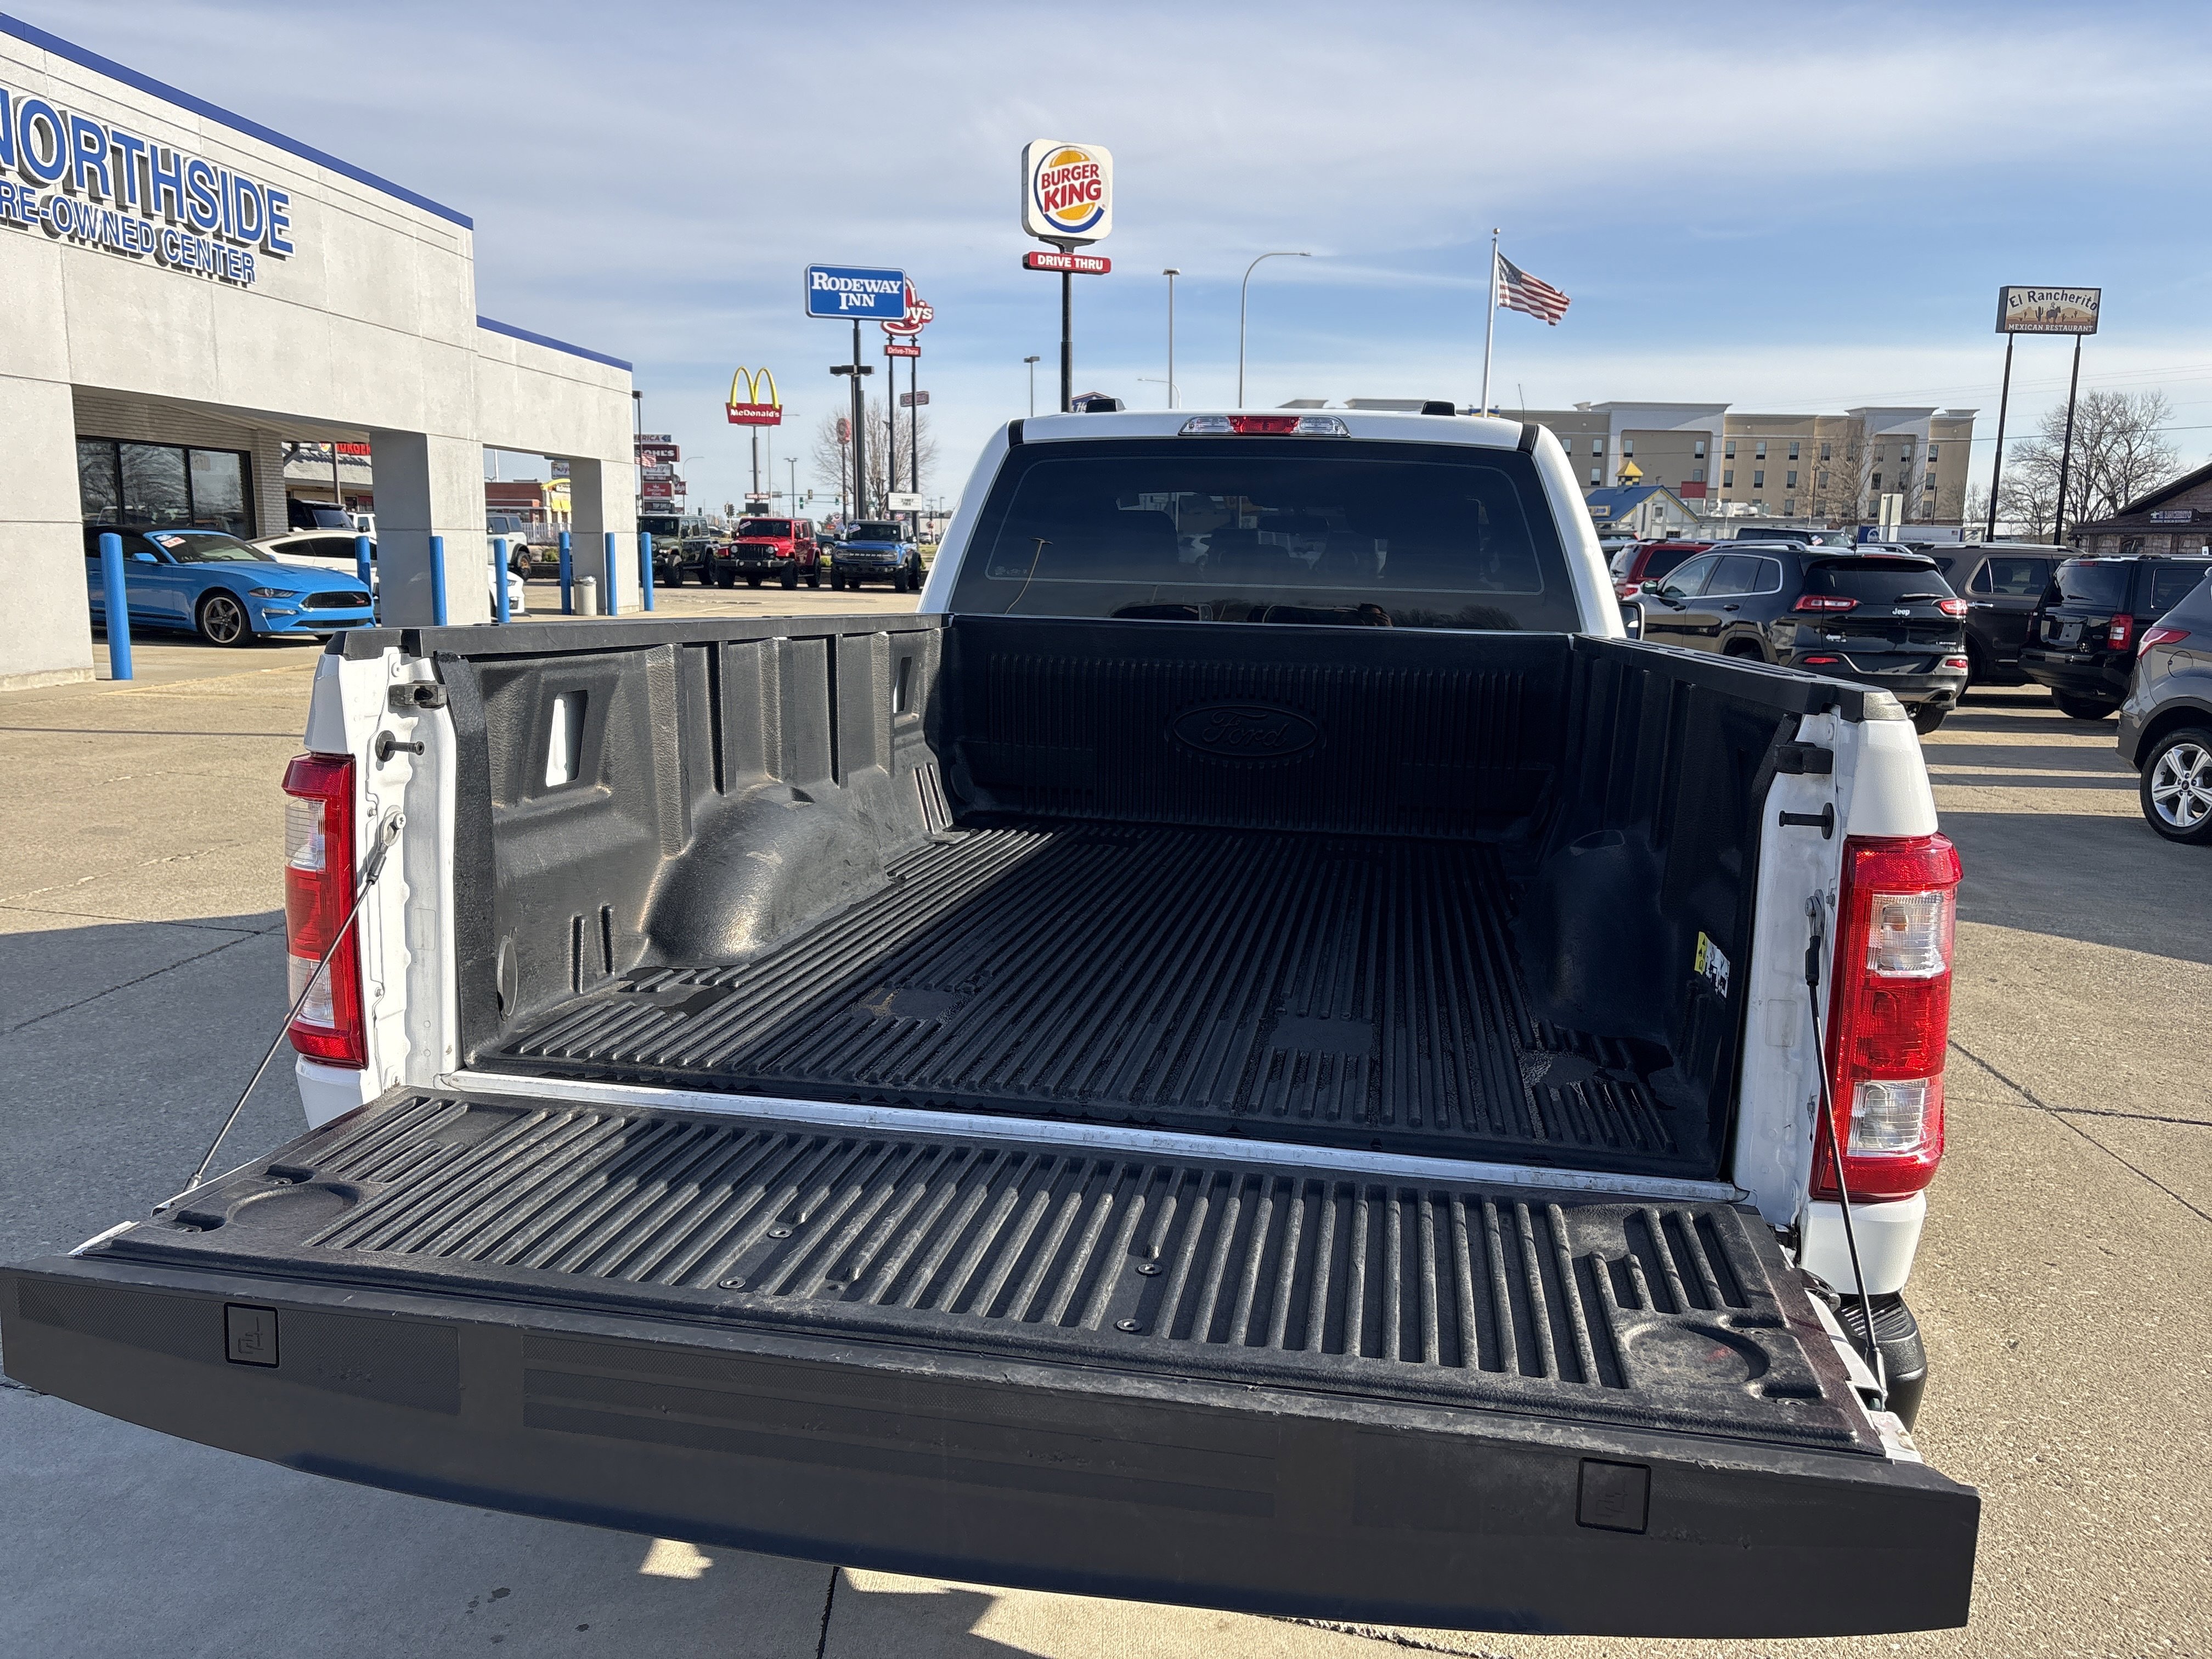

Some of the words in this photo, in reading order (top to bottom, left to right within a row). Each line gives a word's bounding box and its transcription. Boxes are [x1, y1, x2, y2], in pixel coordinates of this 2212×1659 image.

[1041, 163, 1099, 190] BURGER
[1044, 179, 1102, 213] KING
[163, 228, 258, 285] CENTER
[1037, 255, 1072, 268] DRIVE
[1074, 257, 1103, 270] THRU
[811, 272, 902, 294] RODEWAY
[839, 292, 876, 310] INN
[2008, 294, 2023, 308] El
[2027, 290, 2097, 311] Rancherito
[2046, 324, 2094, 332] RESTAURANT
[730, 409, 780, 417] McDonald's
[1892, 607, 1910, 617] Jeep
[1203, 710, 1290, 747] Ford
